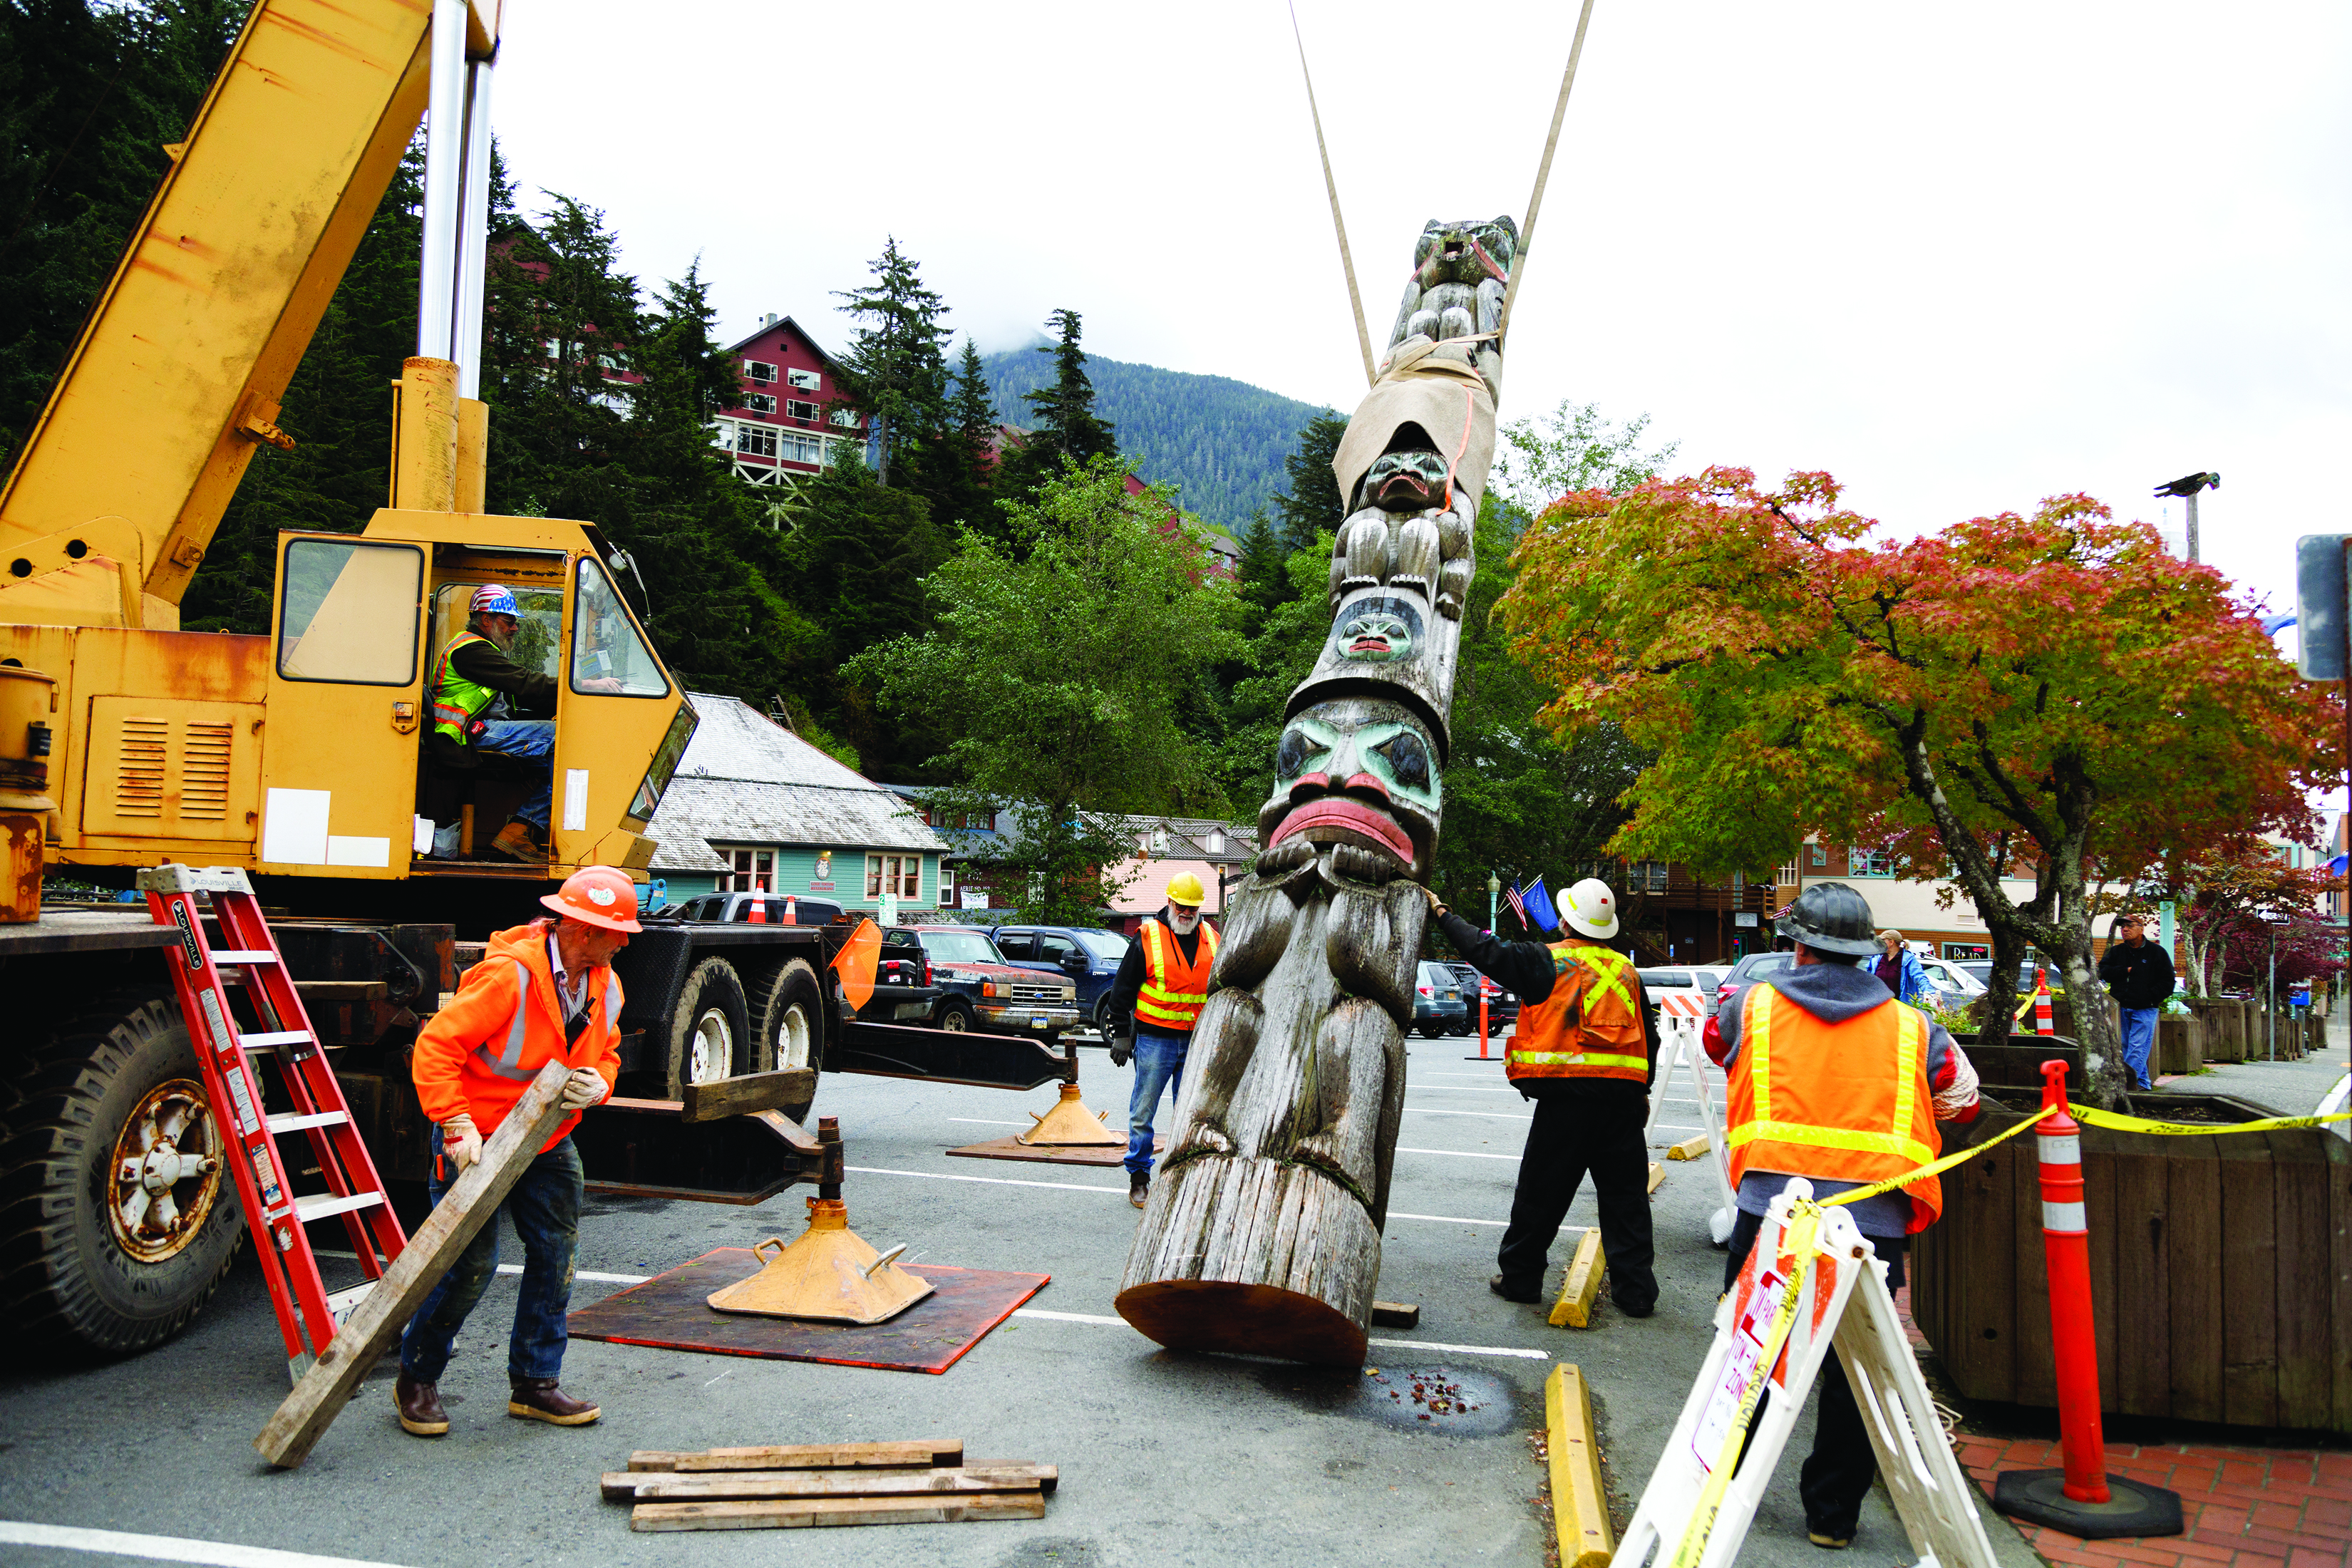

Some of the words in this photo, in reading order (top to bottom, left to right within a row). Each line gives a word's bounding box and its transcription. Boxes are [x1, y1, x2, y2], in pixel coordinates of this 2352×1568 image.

[570, 774, 585, 783] FIRE
[880, 895, 884, 904] 2
[178, 912, 200, 968] LOUISVILLE
[1748, 1283, 1769, 1321] NO
